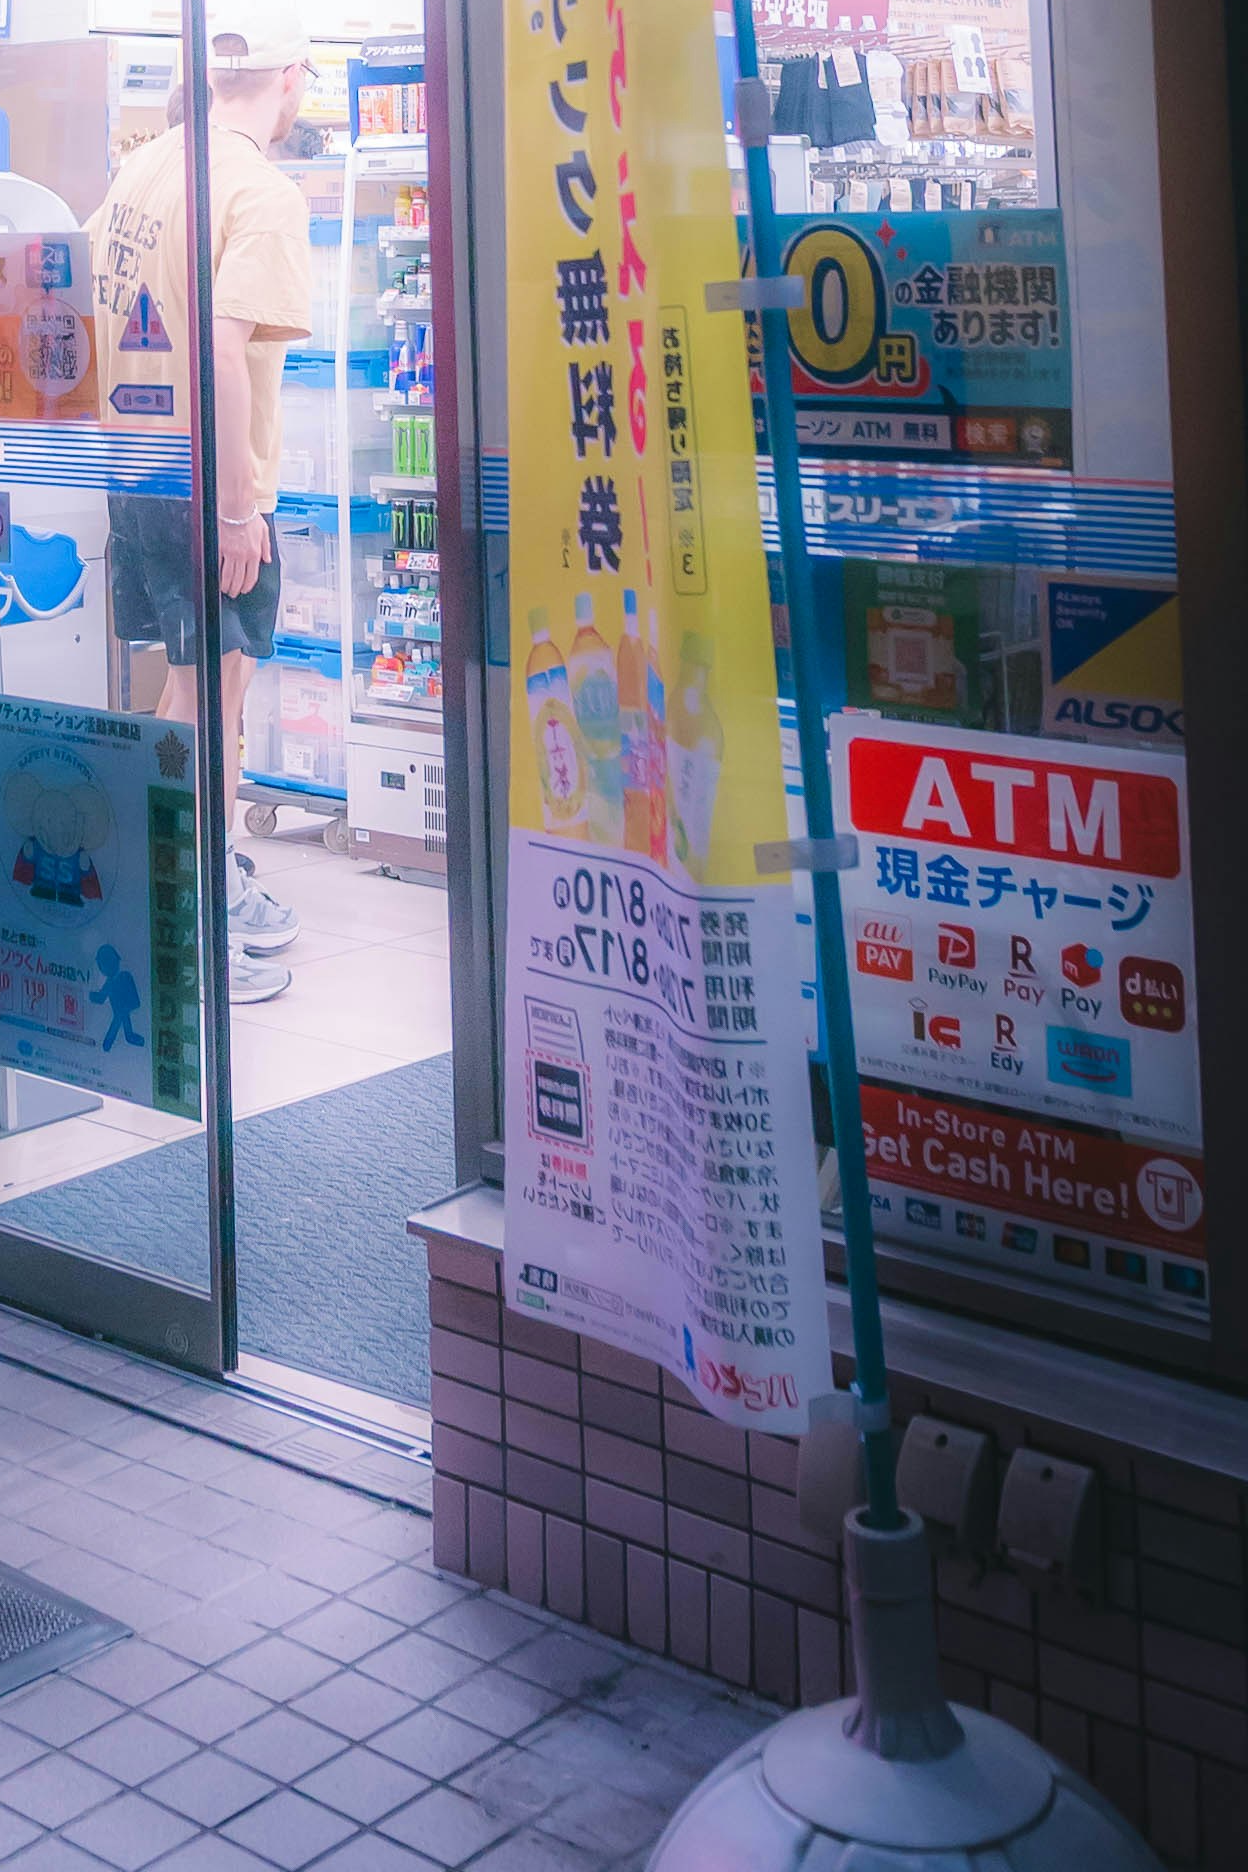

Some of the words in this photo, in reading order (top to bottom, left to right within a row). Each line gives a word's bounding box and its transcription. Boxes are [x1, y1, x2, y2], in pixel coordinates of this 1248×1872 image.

[894, 264, 1058, 307] の金融機関
[933, 309, 1061, 347] あります!
[852, 422, 892, 440] ATM
[902, 421, 940, 443] 無料
[1055, 696, 1185, 737] ALSOK
[901, 755, 1122, 862] ATM
[876, 845, 1157, 932] 現金チャージ
[863, 920, 904, 944] au
[865, 946, 904, 972] PAY
[927, 967, 989, 997] PayPay
[1002, 978, 1046, 1008] Pay
[1060, 986, 1104, 1021] Pay
[989, 1051, 1024, 1076] Edy
[896, 1098, 1007, 1149] In-Store
[1017, 1129, 1077, 1165] ATM
[922, 1138, 1012, 1192] Cash
[1023, 1158, 1130, 1220] Here!
